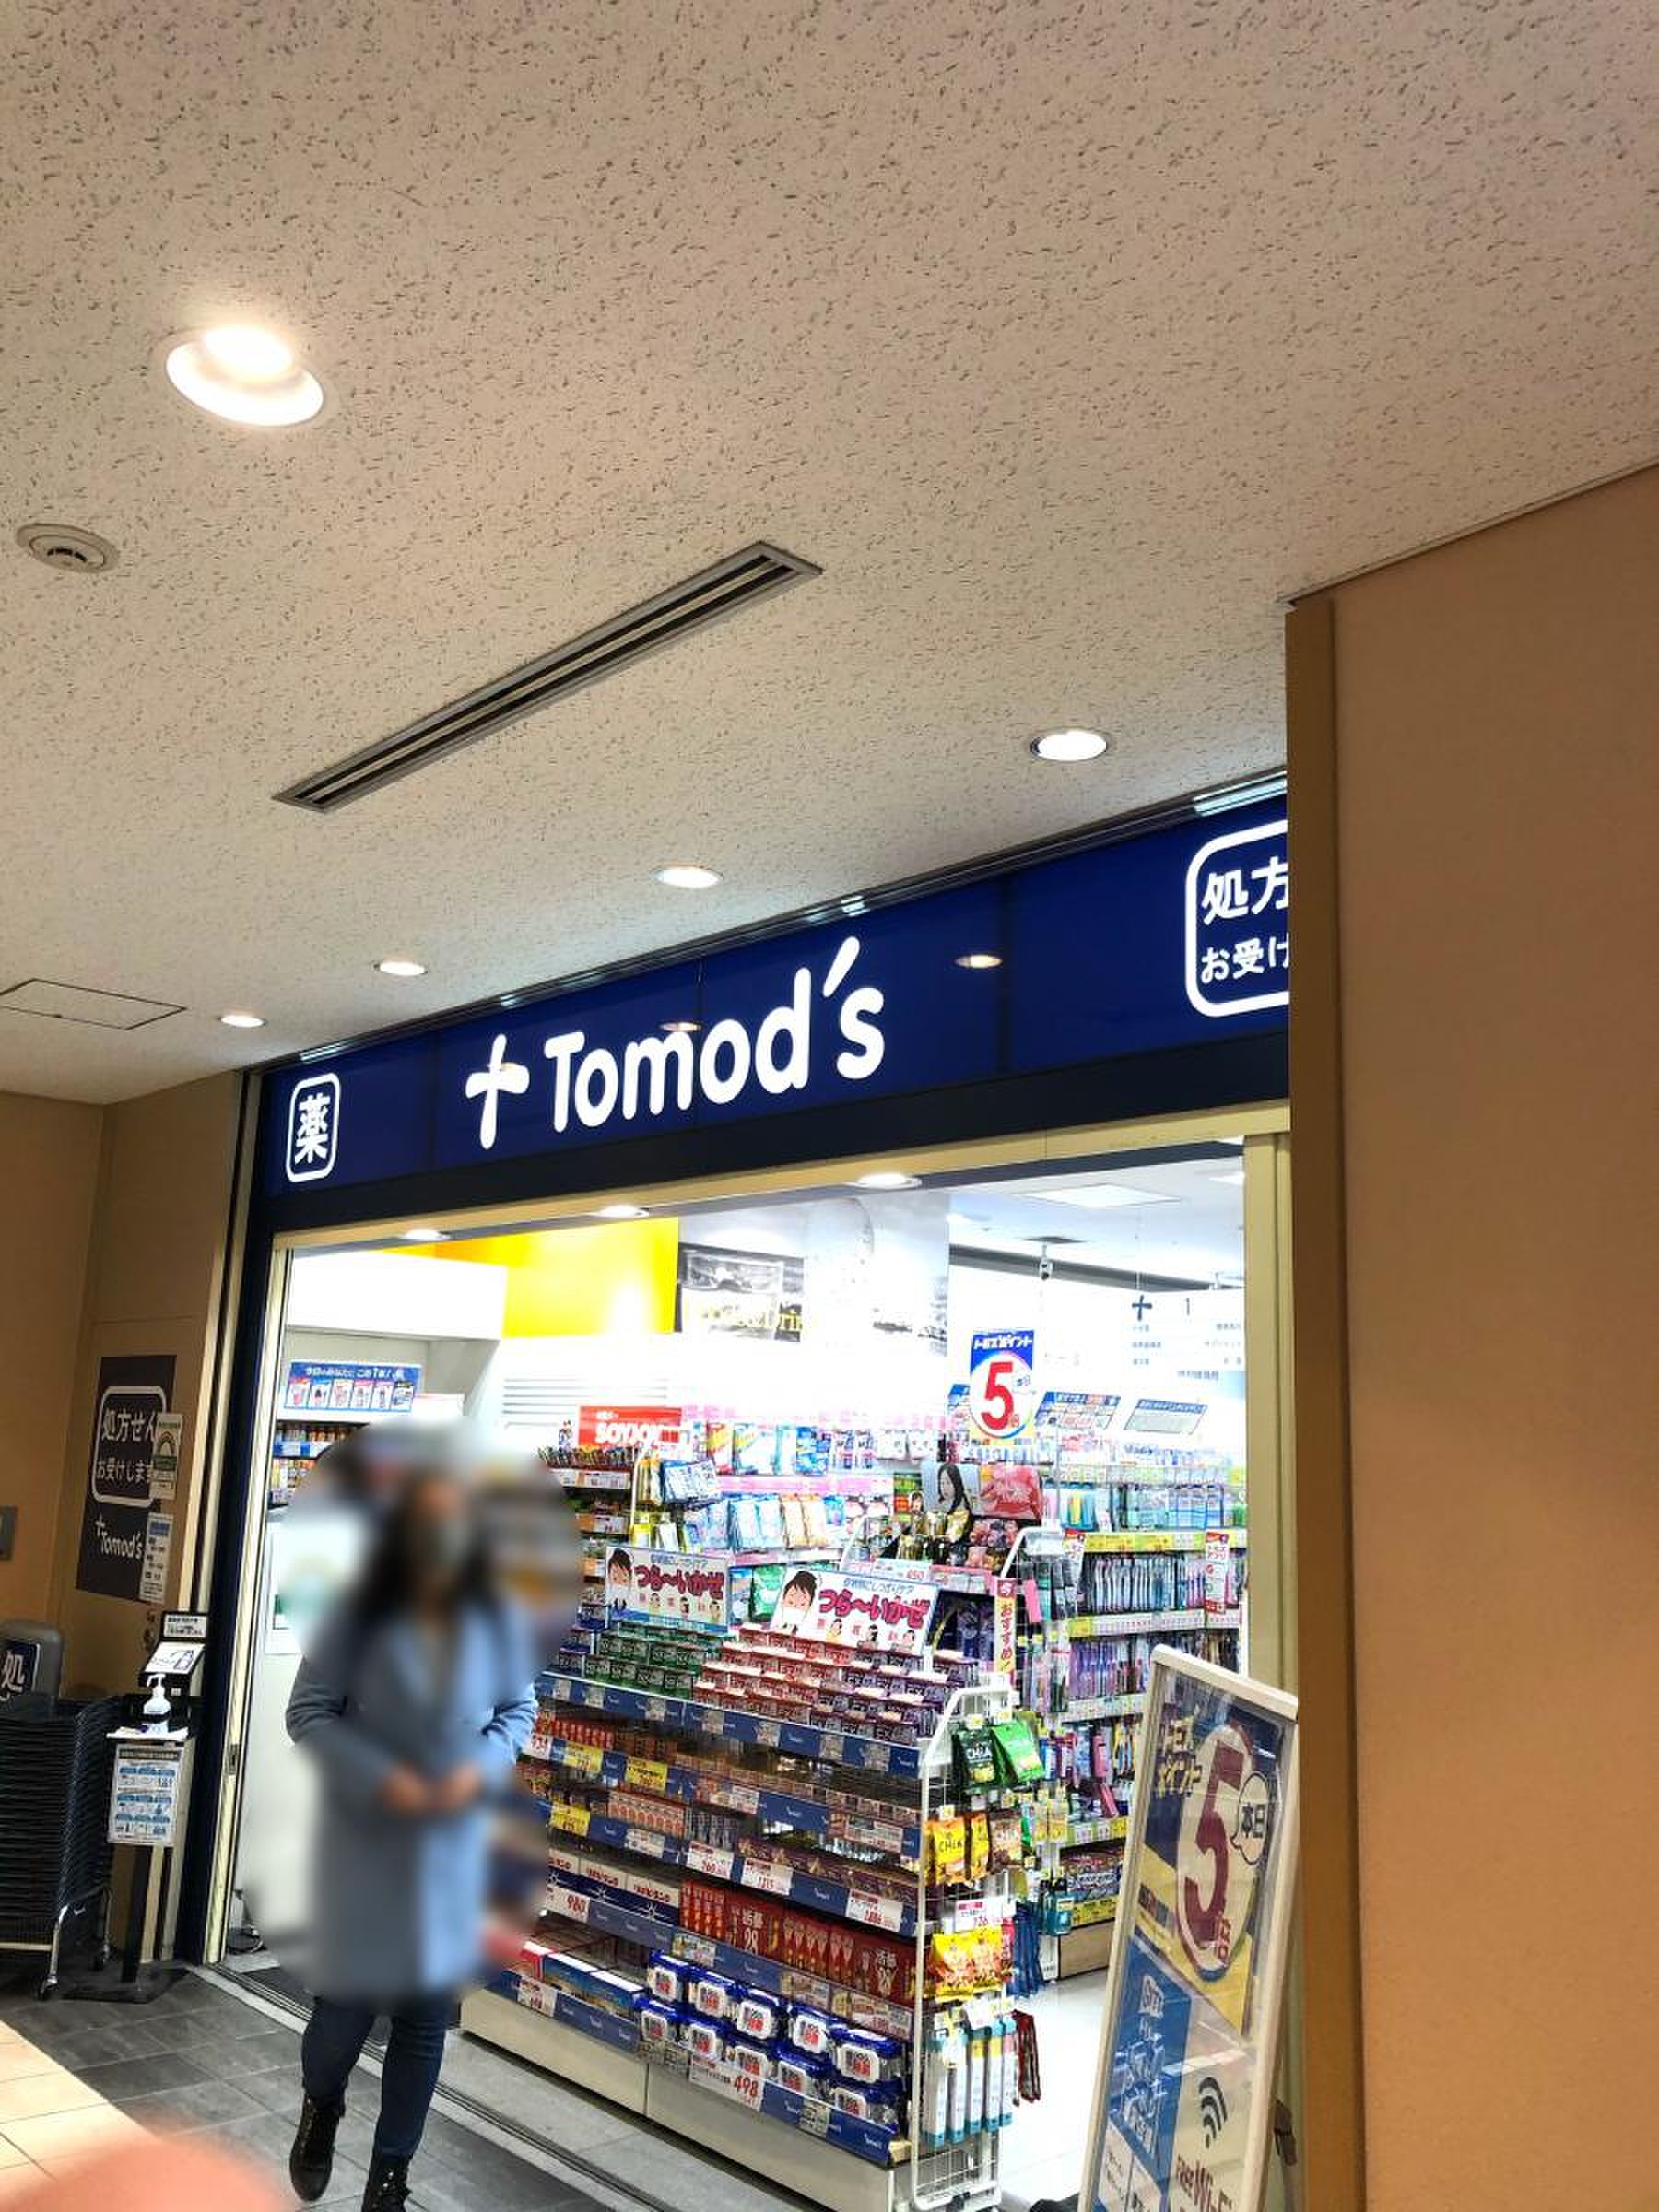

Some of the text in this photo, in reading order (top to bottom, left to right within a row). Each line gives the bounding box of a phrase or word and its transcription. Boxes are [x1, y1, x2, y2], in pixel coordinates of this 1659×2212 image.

[1201, 855, 1289, 926] 処方
[544, 935, 886, 1133] Tomod's
[294, 1092, 331, 1165] 薬
[981, 1361, 1014, 1431] 5
[100, 1531, 143, 1560] Tomod's
[1184, 1740, 1244, 1943] 5
[1241, 1801, 1265, 1840] 本日
